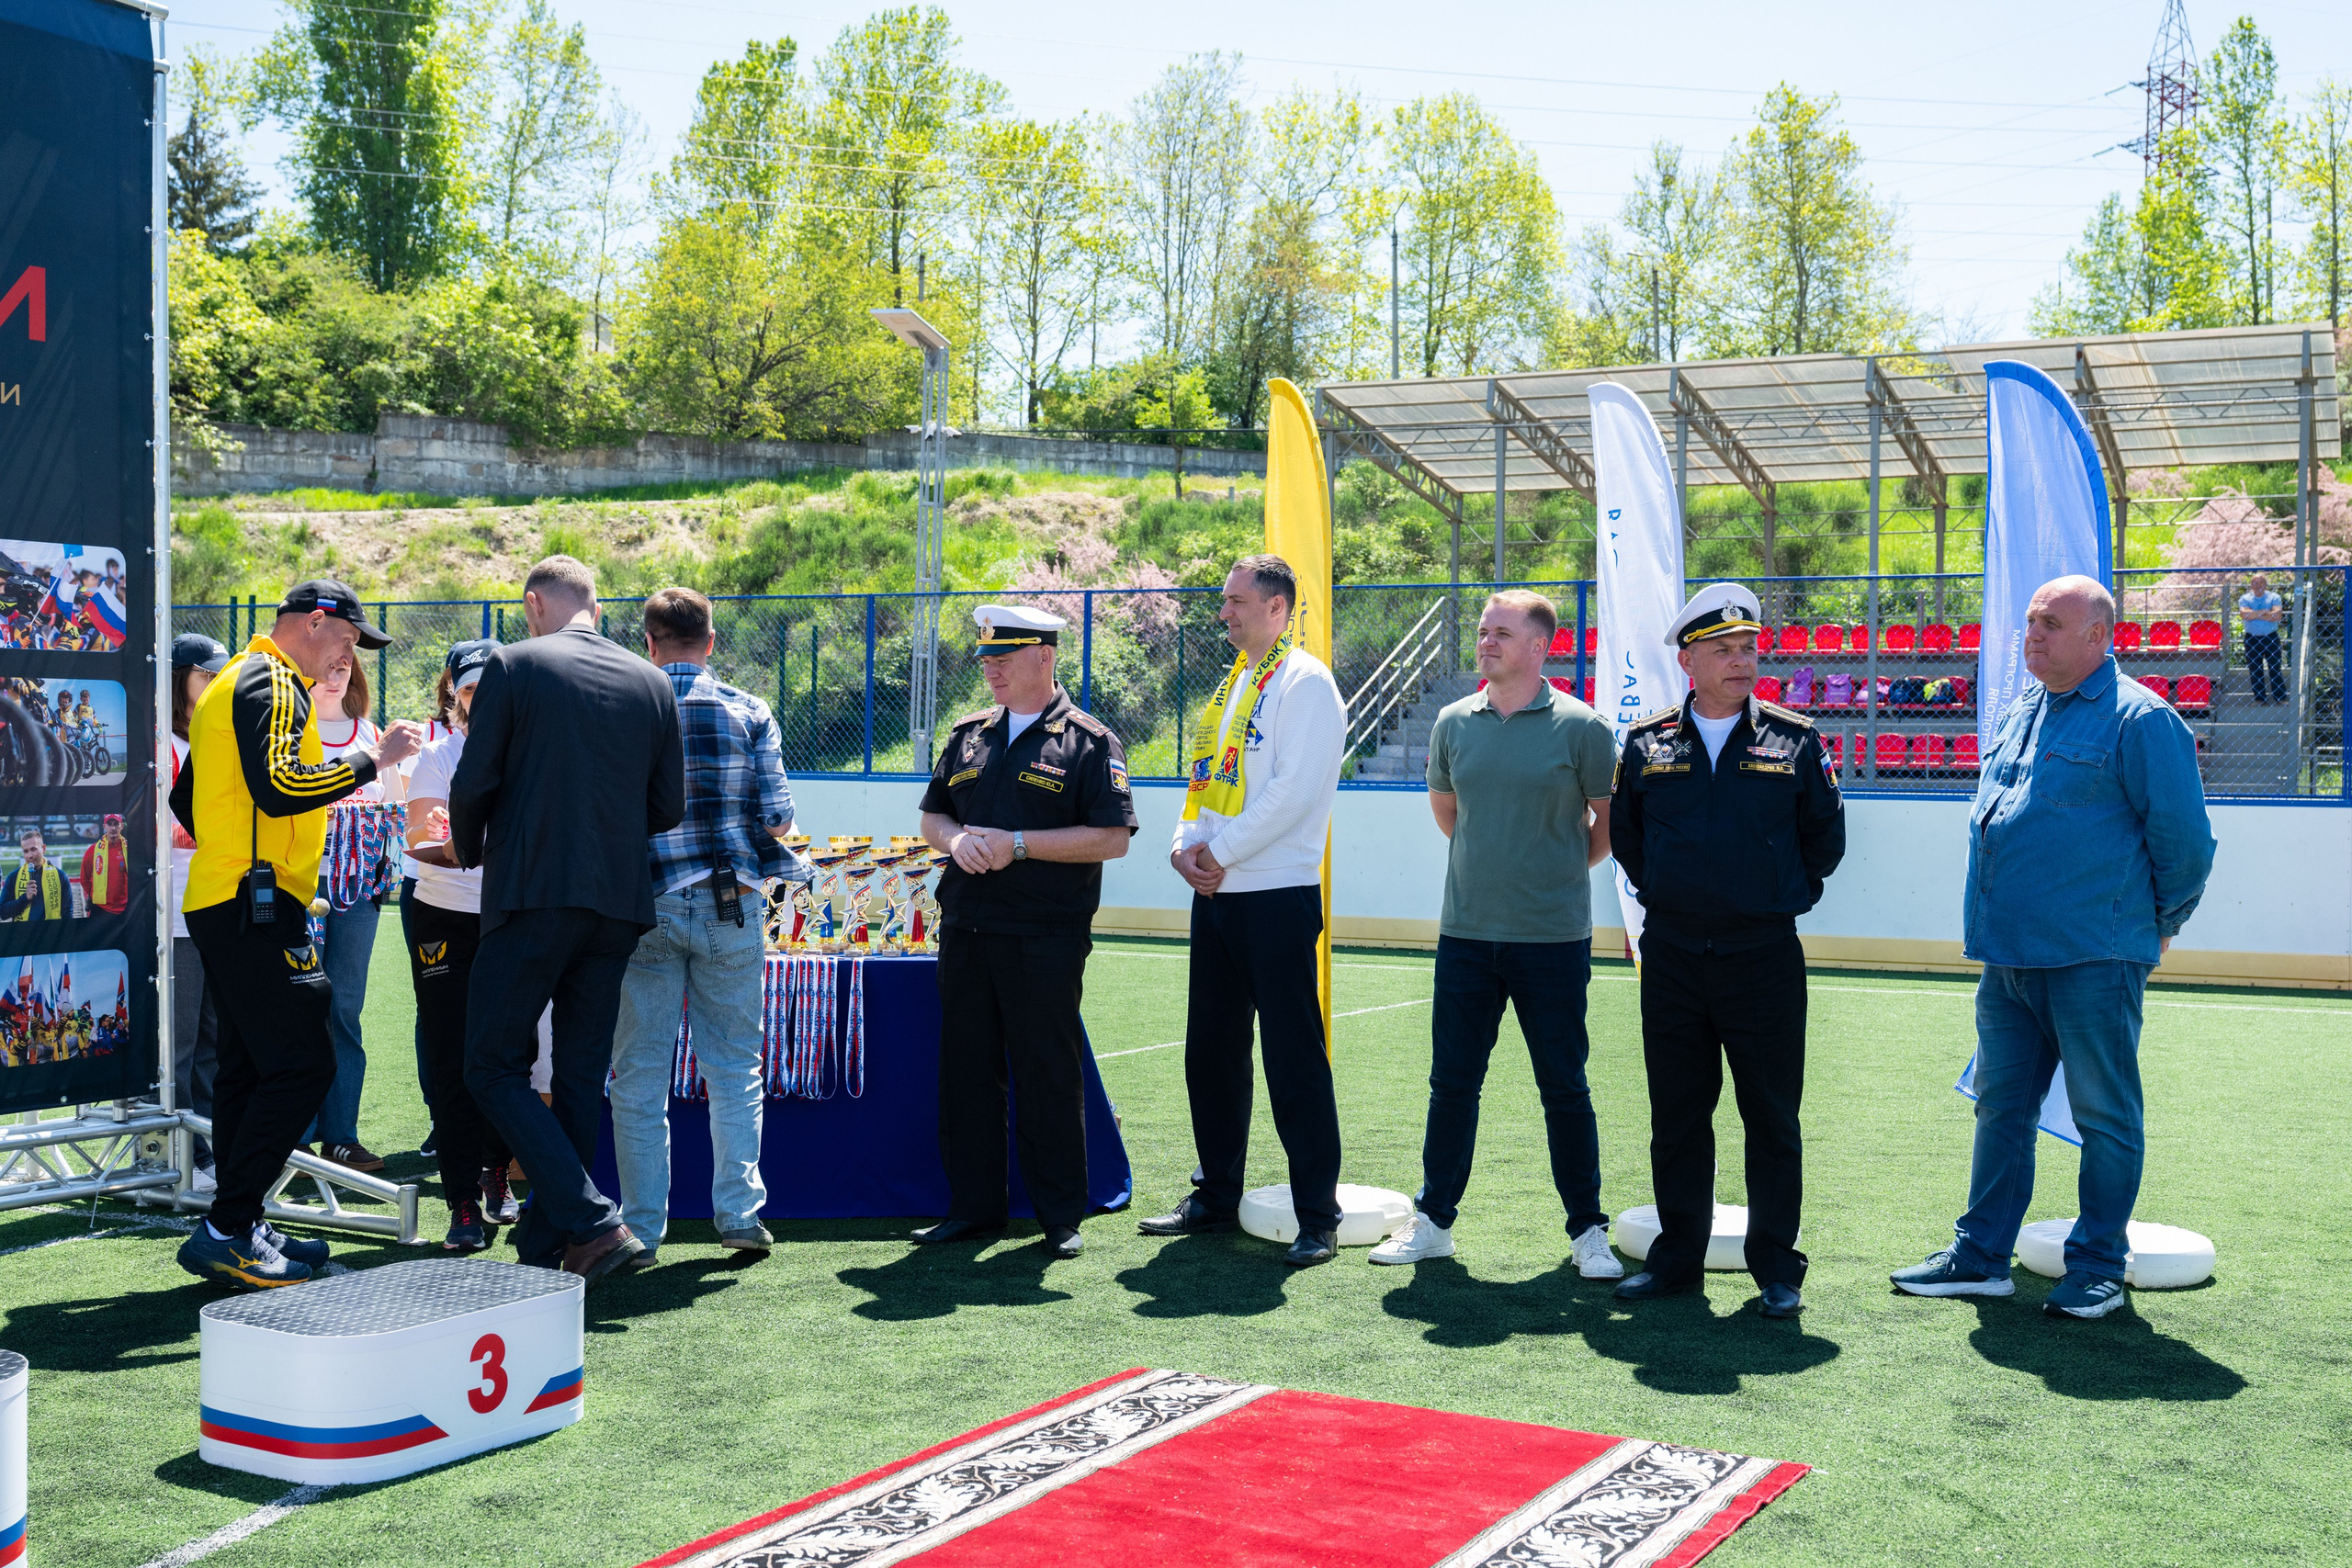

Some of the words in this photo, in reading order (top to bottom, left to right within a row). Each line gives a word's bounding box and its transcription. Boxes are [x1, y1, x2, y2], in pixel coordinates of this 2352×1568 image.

[1251, 644, 1283, 686] КУБОК
[1214, 773, 1239, 788] ФТРК
[468, 1333, 508, 1414] 3
